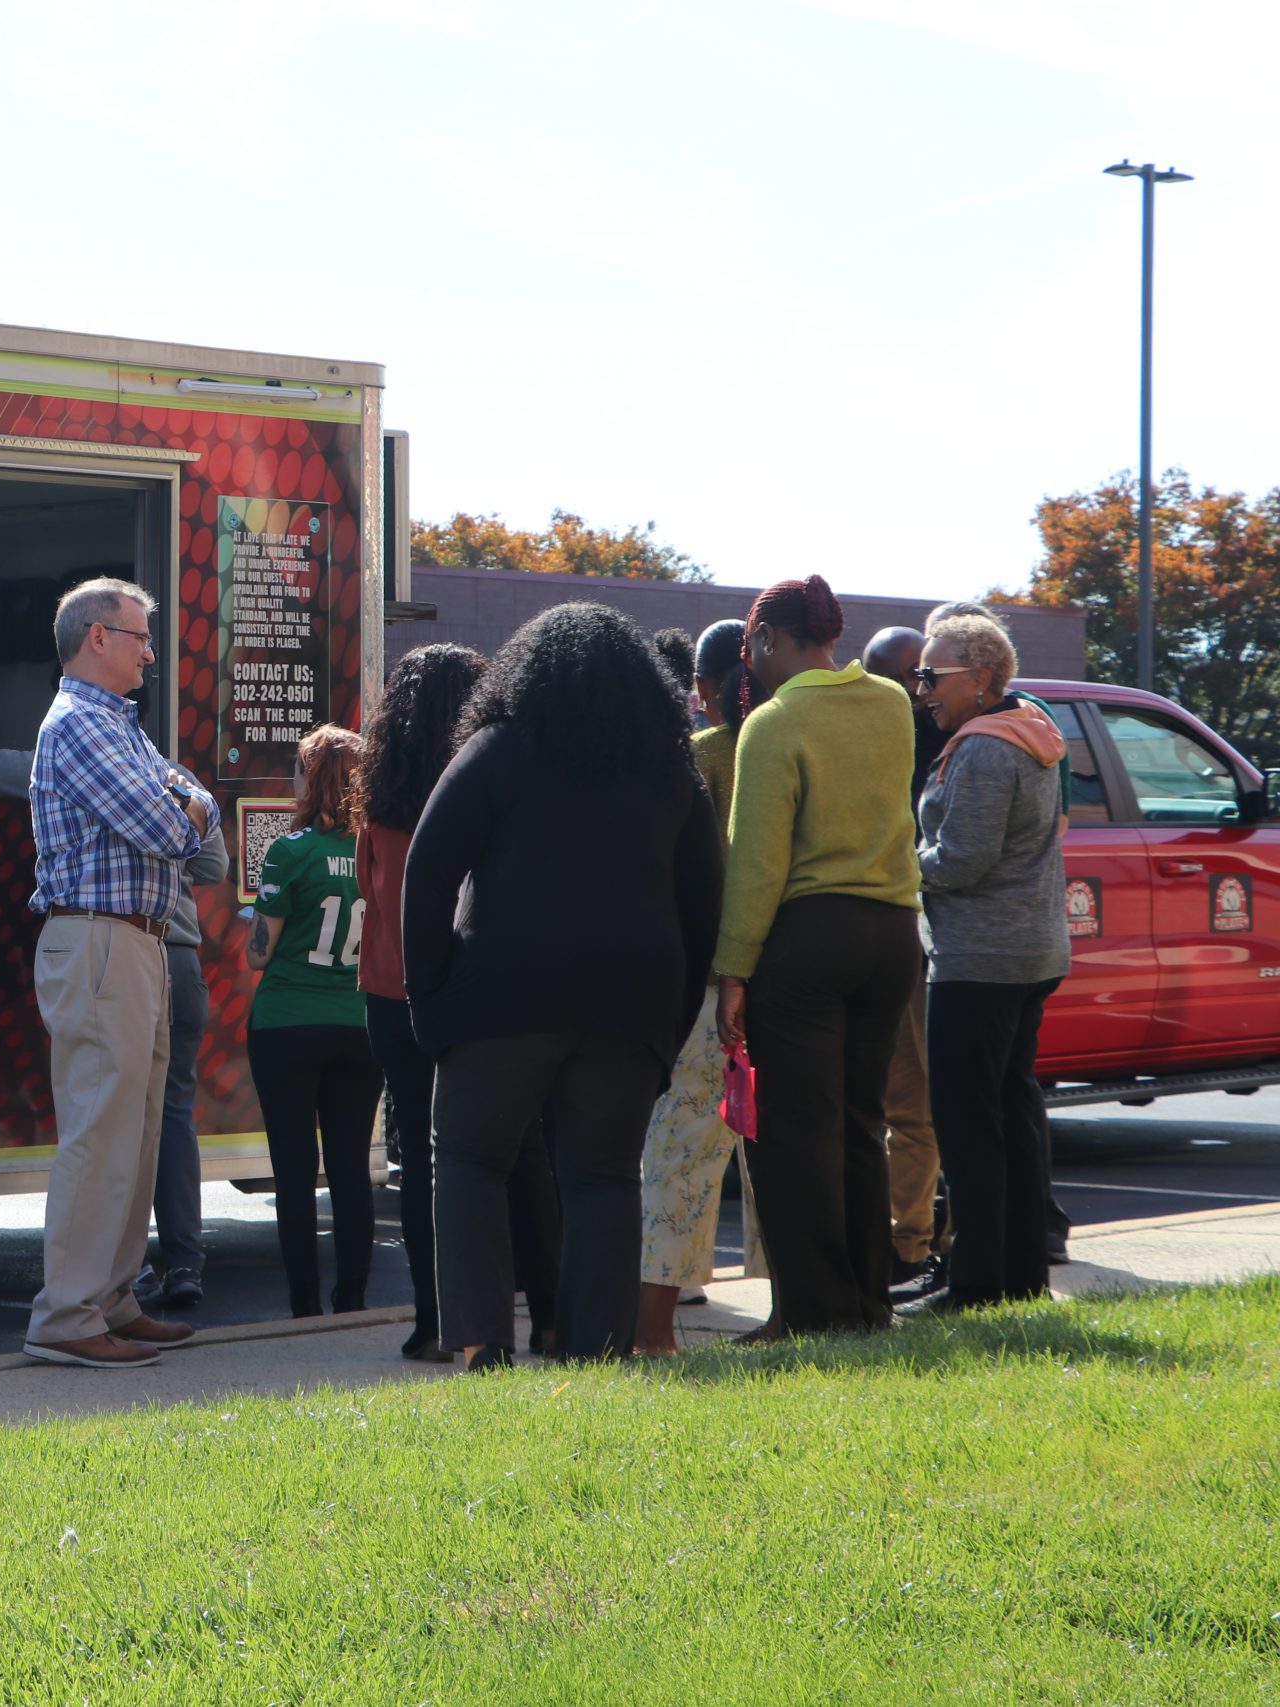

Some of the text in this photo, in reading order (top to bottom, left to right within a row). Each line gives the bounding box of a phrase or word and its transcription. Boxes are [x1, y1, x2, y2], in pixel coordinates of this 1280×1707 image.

[233, 530, 310, 546] AT LOVE THAT PLATE WE
[233, 545, 305, 558] PROVIDE A WONDERFUL
[233, 558, 310, 572] AND UNIQUE EXPERIENCE
[233, 571, 295, 585] FOR OUR GUEST, BY
[233, 584, 310, 598] UPHOLDING OUR FOOD TO
[233, 597, 284, 609] A HIGH QUALITY
[233, 610, 310, 623] STANDARD, AND WILL BE
[233, 623, 310, 637] CONSISTENT EVERY TIME
[233, 636, 301, 649] AN ORDER IS PLACED.
[234, 663, 313, 682] CONTACT US:
[233, 684, 314, 702] 302-242-0501
[234, 707, 313, 722] SCAN THE CODE
[245, 727, 302, 742] FOR MORE
[327, 856, 358, 878] WAT
